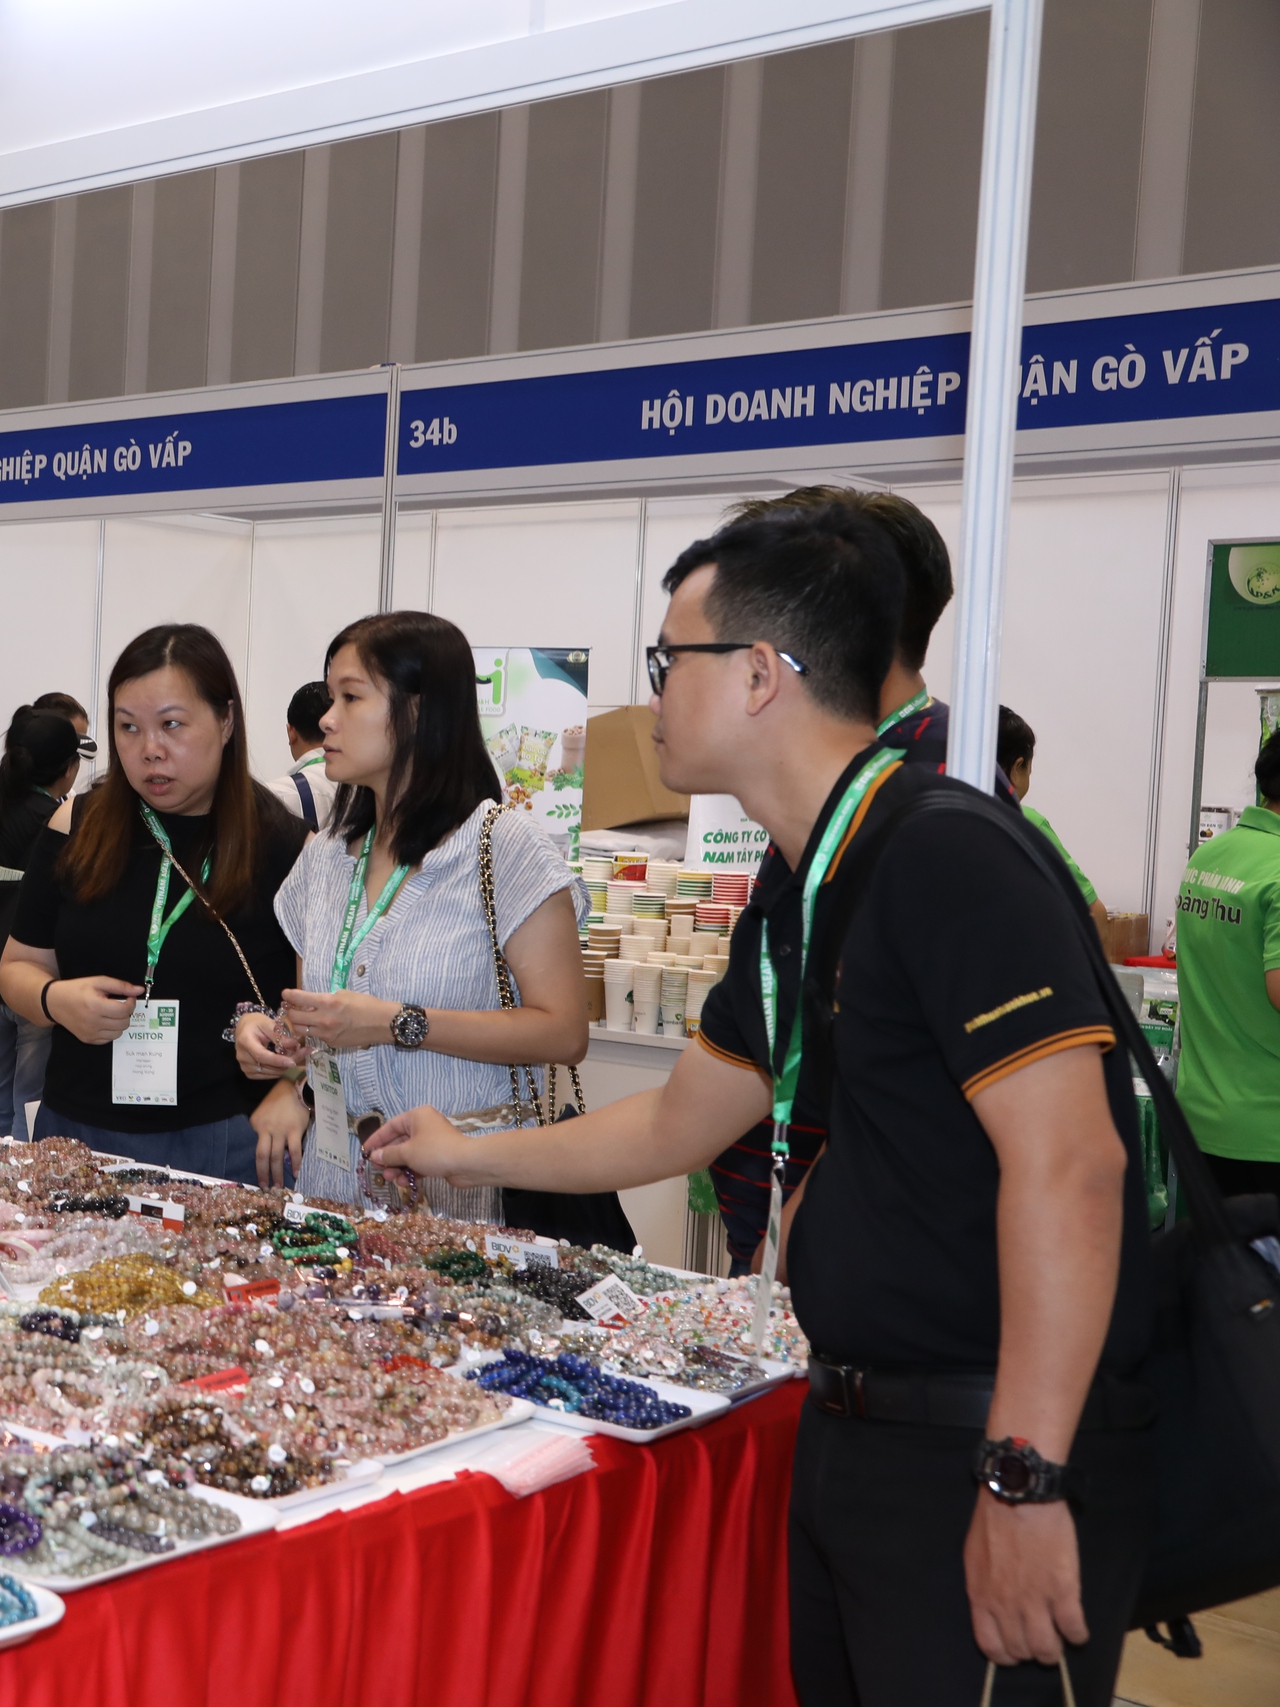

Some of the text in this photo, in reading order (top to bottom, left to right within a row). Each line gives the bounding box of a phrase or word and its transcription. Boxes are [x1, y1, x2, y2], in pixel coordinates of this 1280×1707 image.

[641, 328, 1250, 436] HỘI DOANH NGHIỆP ẬN GÒ VẤP
[409, 416, 458, 448] 34b
[52, 444, 107, 481] QUẬN
[113, 438, 141, 472] GÒ
[148, 430, 193, 469] VẤP
[702, 828, 739, 844] CÔNG
[741, 830, 753, 843] TY
[702, 851, 735, 864] NAM
[737, 847, 754, 863] TÂY
[156, 878, 167, 910] VIETNAM
[346, 904, 357, 930] ASEAN
[362, 908, 381, 931] ASEAN
[1211, 897, 1241, 925] Thu
[761, 958, 774, 996] ASEAN
[128, 1032, 164, 1040] VISITOR
[320, 1082, 339, 1096] VISITOR
[287, 1209, 305, 1220] BIDV
[491, 1241, 513, 1254] BIDV
[582, 1296, 600, 1310] BIDV
